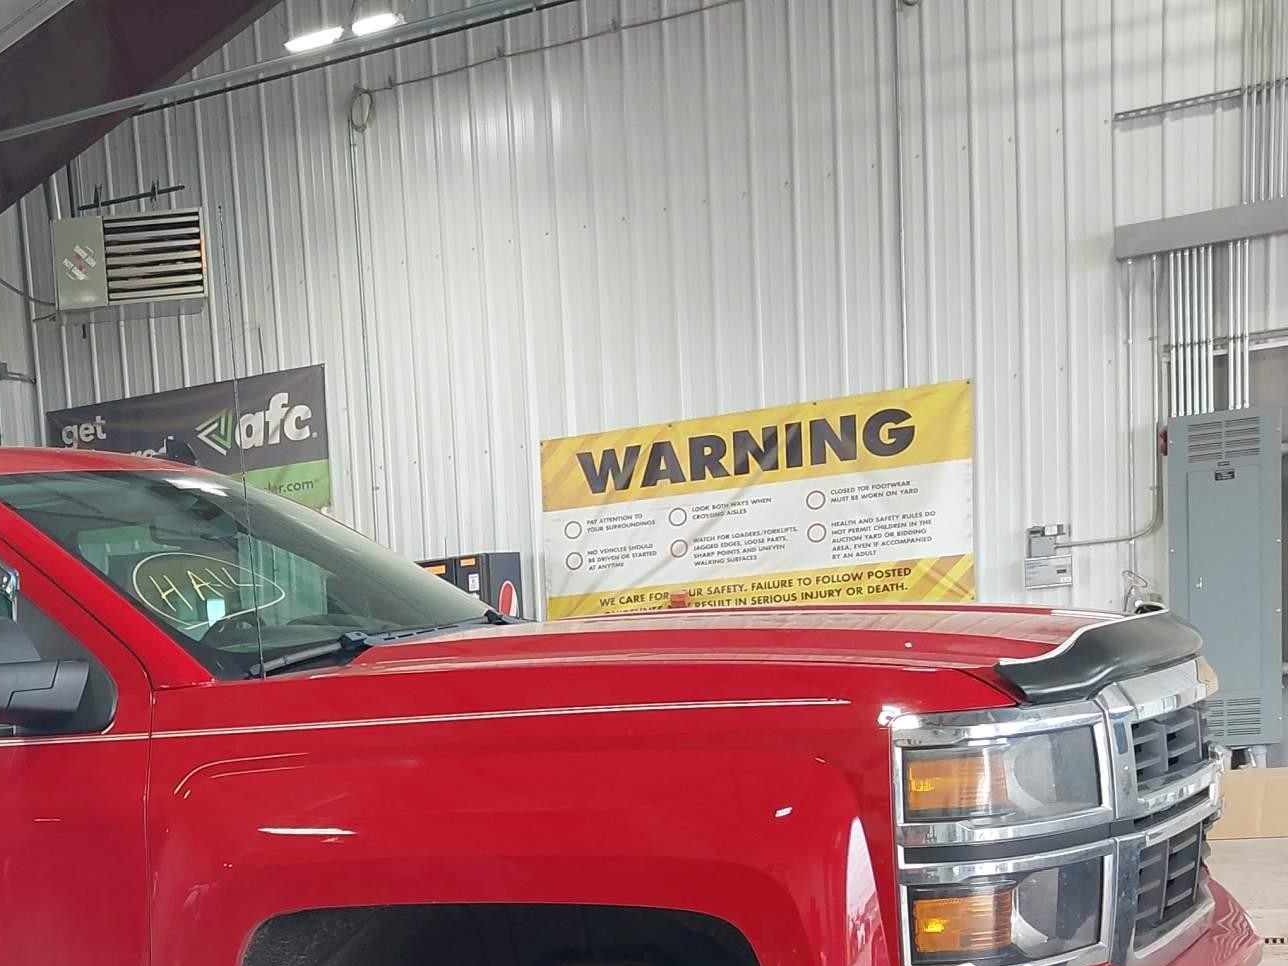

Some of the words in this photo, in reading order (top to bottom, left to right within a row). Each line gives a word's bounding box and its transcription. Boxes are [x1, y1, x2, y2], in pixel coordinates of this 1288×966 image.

[62, 416, 107, 449] get
[577, 409, 915, 494] WARNING
[830, 487, 856, 495] CLOSED
[871, 480, 911, 491] FOOTWEAR
[730, 500, 749, 508] WAYS
[830, 496, 849, 504] MUST
[860, 492, 883, 500] WORN
[598, 515, 632, 524] ATTENTION
[692, 511, 725, 520] CROSSING
[831, 520, 857, 528] HEALTH
[875, 514, 900, 523] SAFETY
[605, 520, 656, 531] SURROUNDINGS
[847, 526, 872, 534] PERMIT
[873, 522, 907, 531] CHILDREN
[693, 535, 716, 543] WATCH
[831, 535, 862, 544] AUCTION
[896, 528, 927, 537] BIDDING
[600, 545, 627, 554] VEHICLES
[628, 543, 653, 551] SHOULD
[693, 543, 719, 551] JAGGED
[853, 542, 871, 550] EVEN
[880, 536, 932, 546] ACCOMPANIED
[693, 551, 715, 559] SHARP
[717, 548, 740, 556] POINTS
[758, 544, 785, 552] UNEVEN
[597, 555, 619, 563] DRIVEN
[694, 558, 726, 567] WALKING
[726, 555, 758, 563] SURFACES
[598, 562, 624, 570] ANYTIME
[149, 567, 262, 612] HAIL
[599, 598, 616, 608] WE
[618, 594, 646, 605] CARE
[649, 592, 670, 601] FOR
[706, 584, 748, 596] SAFETY.
[751, 579, 793, 592] FAILURE
[796, 577, 812, 586] TO
[815, 572, 864, 585] FOLLOW
[867, 567, 912, 580] POSTED
[735, 597, 747, 606] IN
[751, 593, 797, 605] SERIOUS
[801, 588, 842, 600] INJURY
[846, 586, 863, 596] OR
[867, 582, 909, 594] DEATH.
